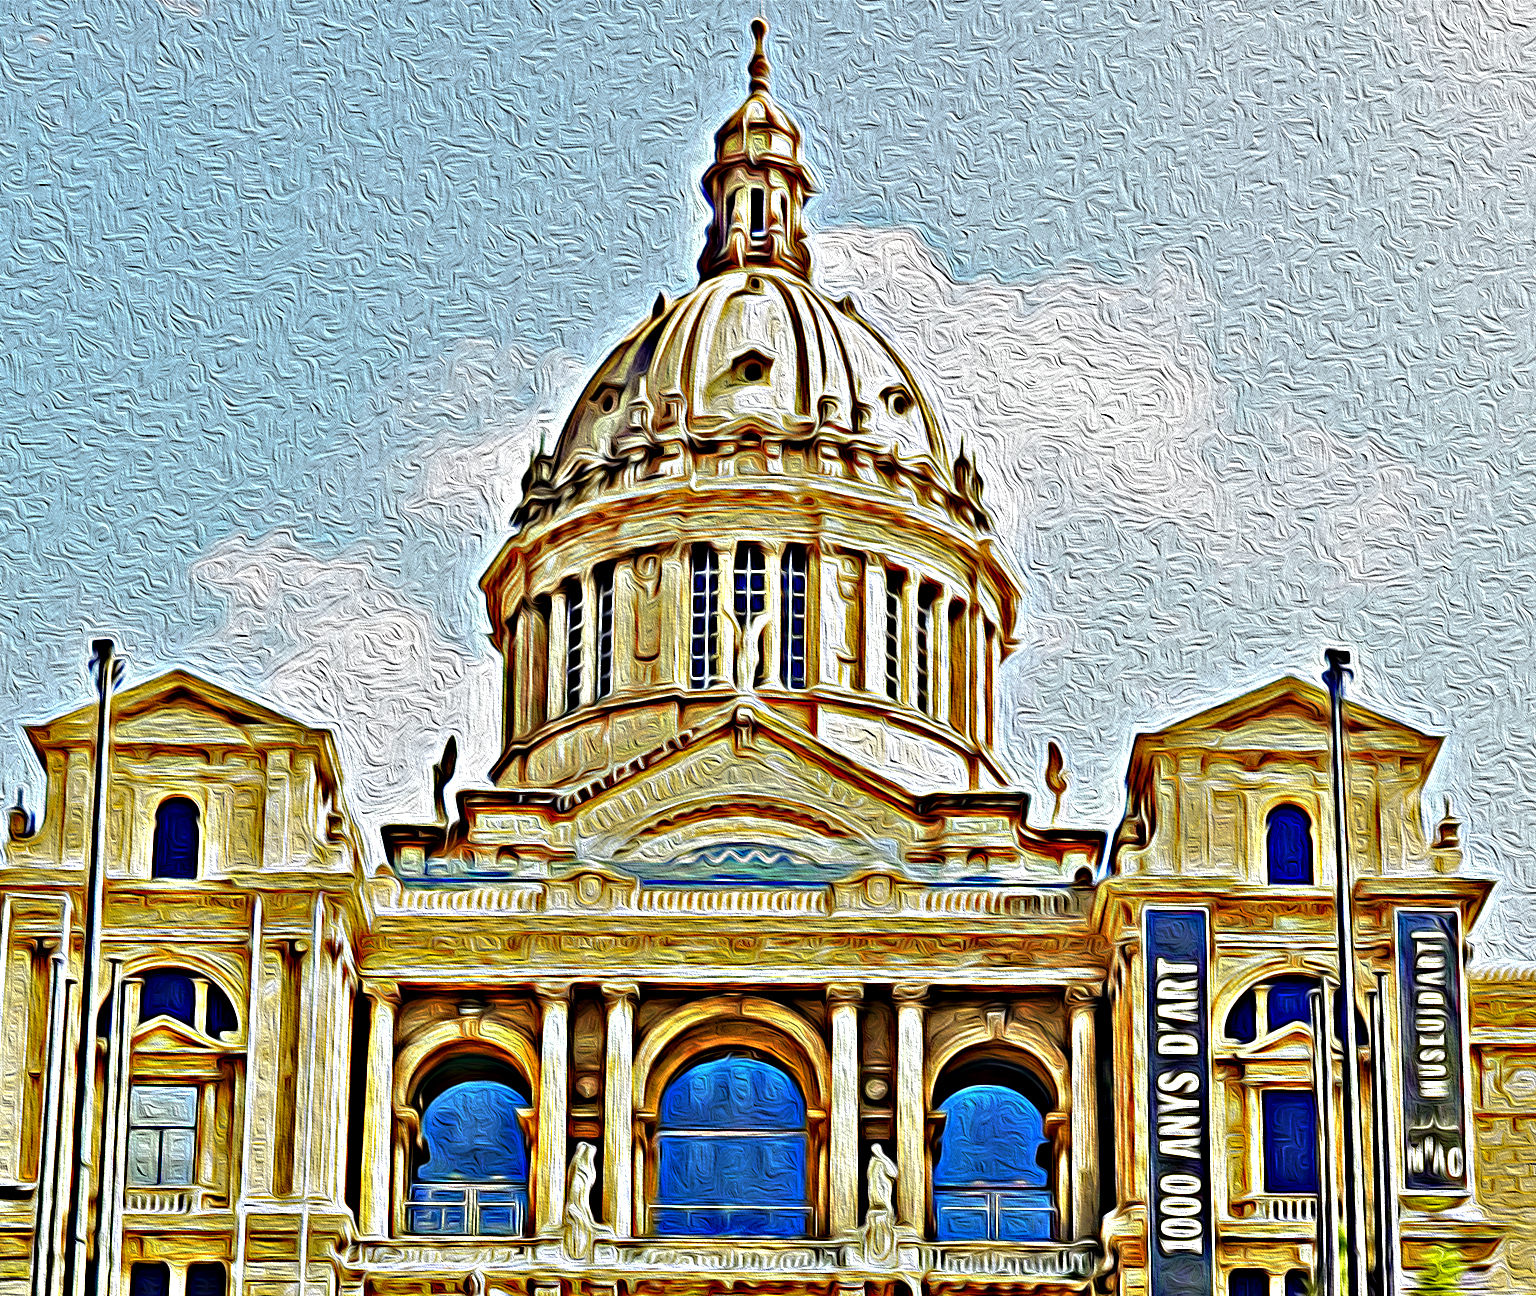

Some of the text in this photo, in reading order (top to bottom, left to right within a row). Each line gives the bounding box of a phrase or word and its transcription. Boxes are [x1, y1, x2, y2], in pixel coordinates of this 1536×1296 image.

[1155, 957, 1204, 1255] 1000 ANYS D'ART
